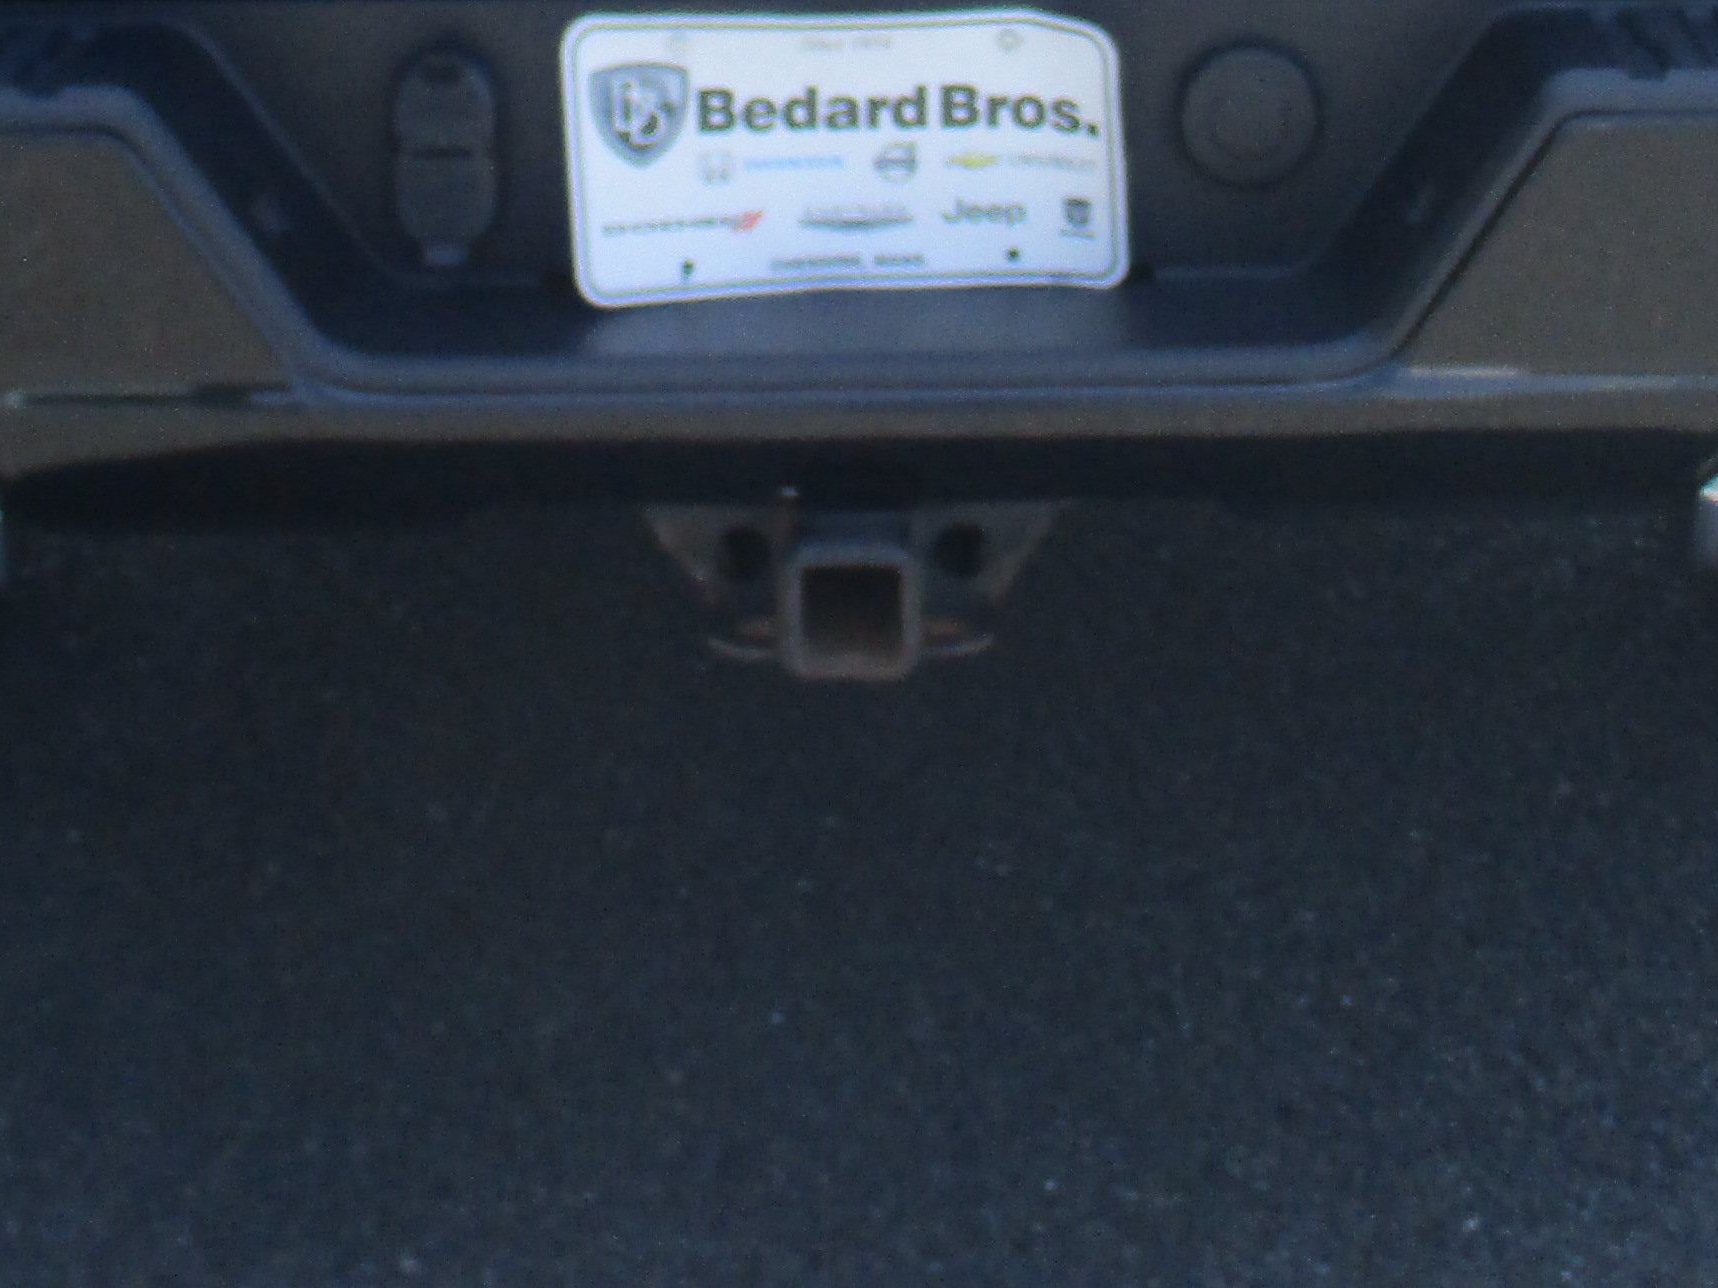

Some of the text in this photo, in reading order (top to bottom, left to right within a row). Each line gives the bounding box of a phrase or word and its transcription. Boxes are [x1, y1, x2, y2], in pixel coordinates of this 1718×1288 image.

[696, 83, 1101, 138] Bedard Bros.
[941, 197, 1027, 228] Jeep
